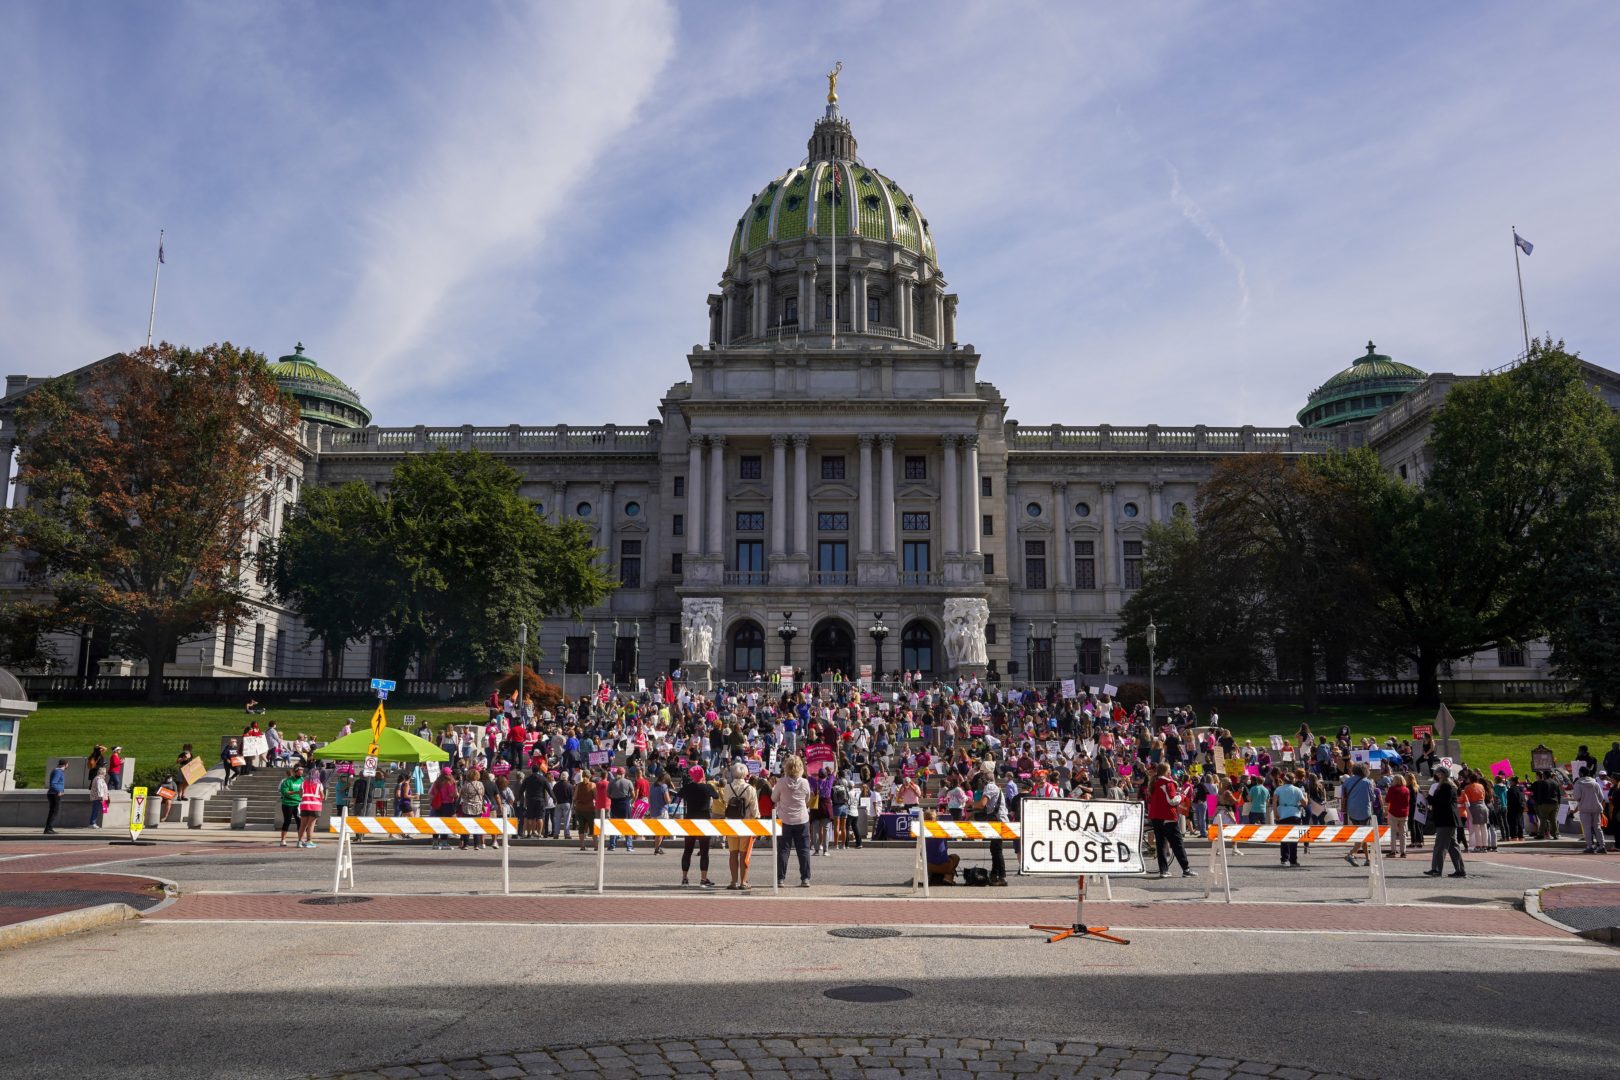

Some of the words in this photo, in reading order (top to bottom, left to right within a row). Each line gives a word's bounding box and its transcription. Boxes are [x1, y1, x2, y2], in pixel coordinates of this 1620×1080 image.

[1048, 809, 1118, 833] ROAD
[1298, 829, 1310, 839] HTE
[1031, 840, 1131, 863] CLOSED
